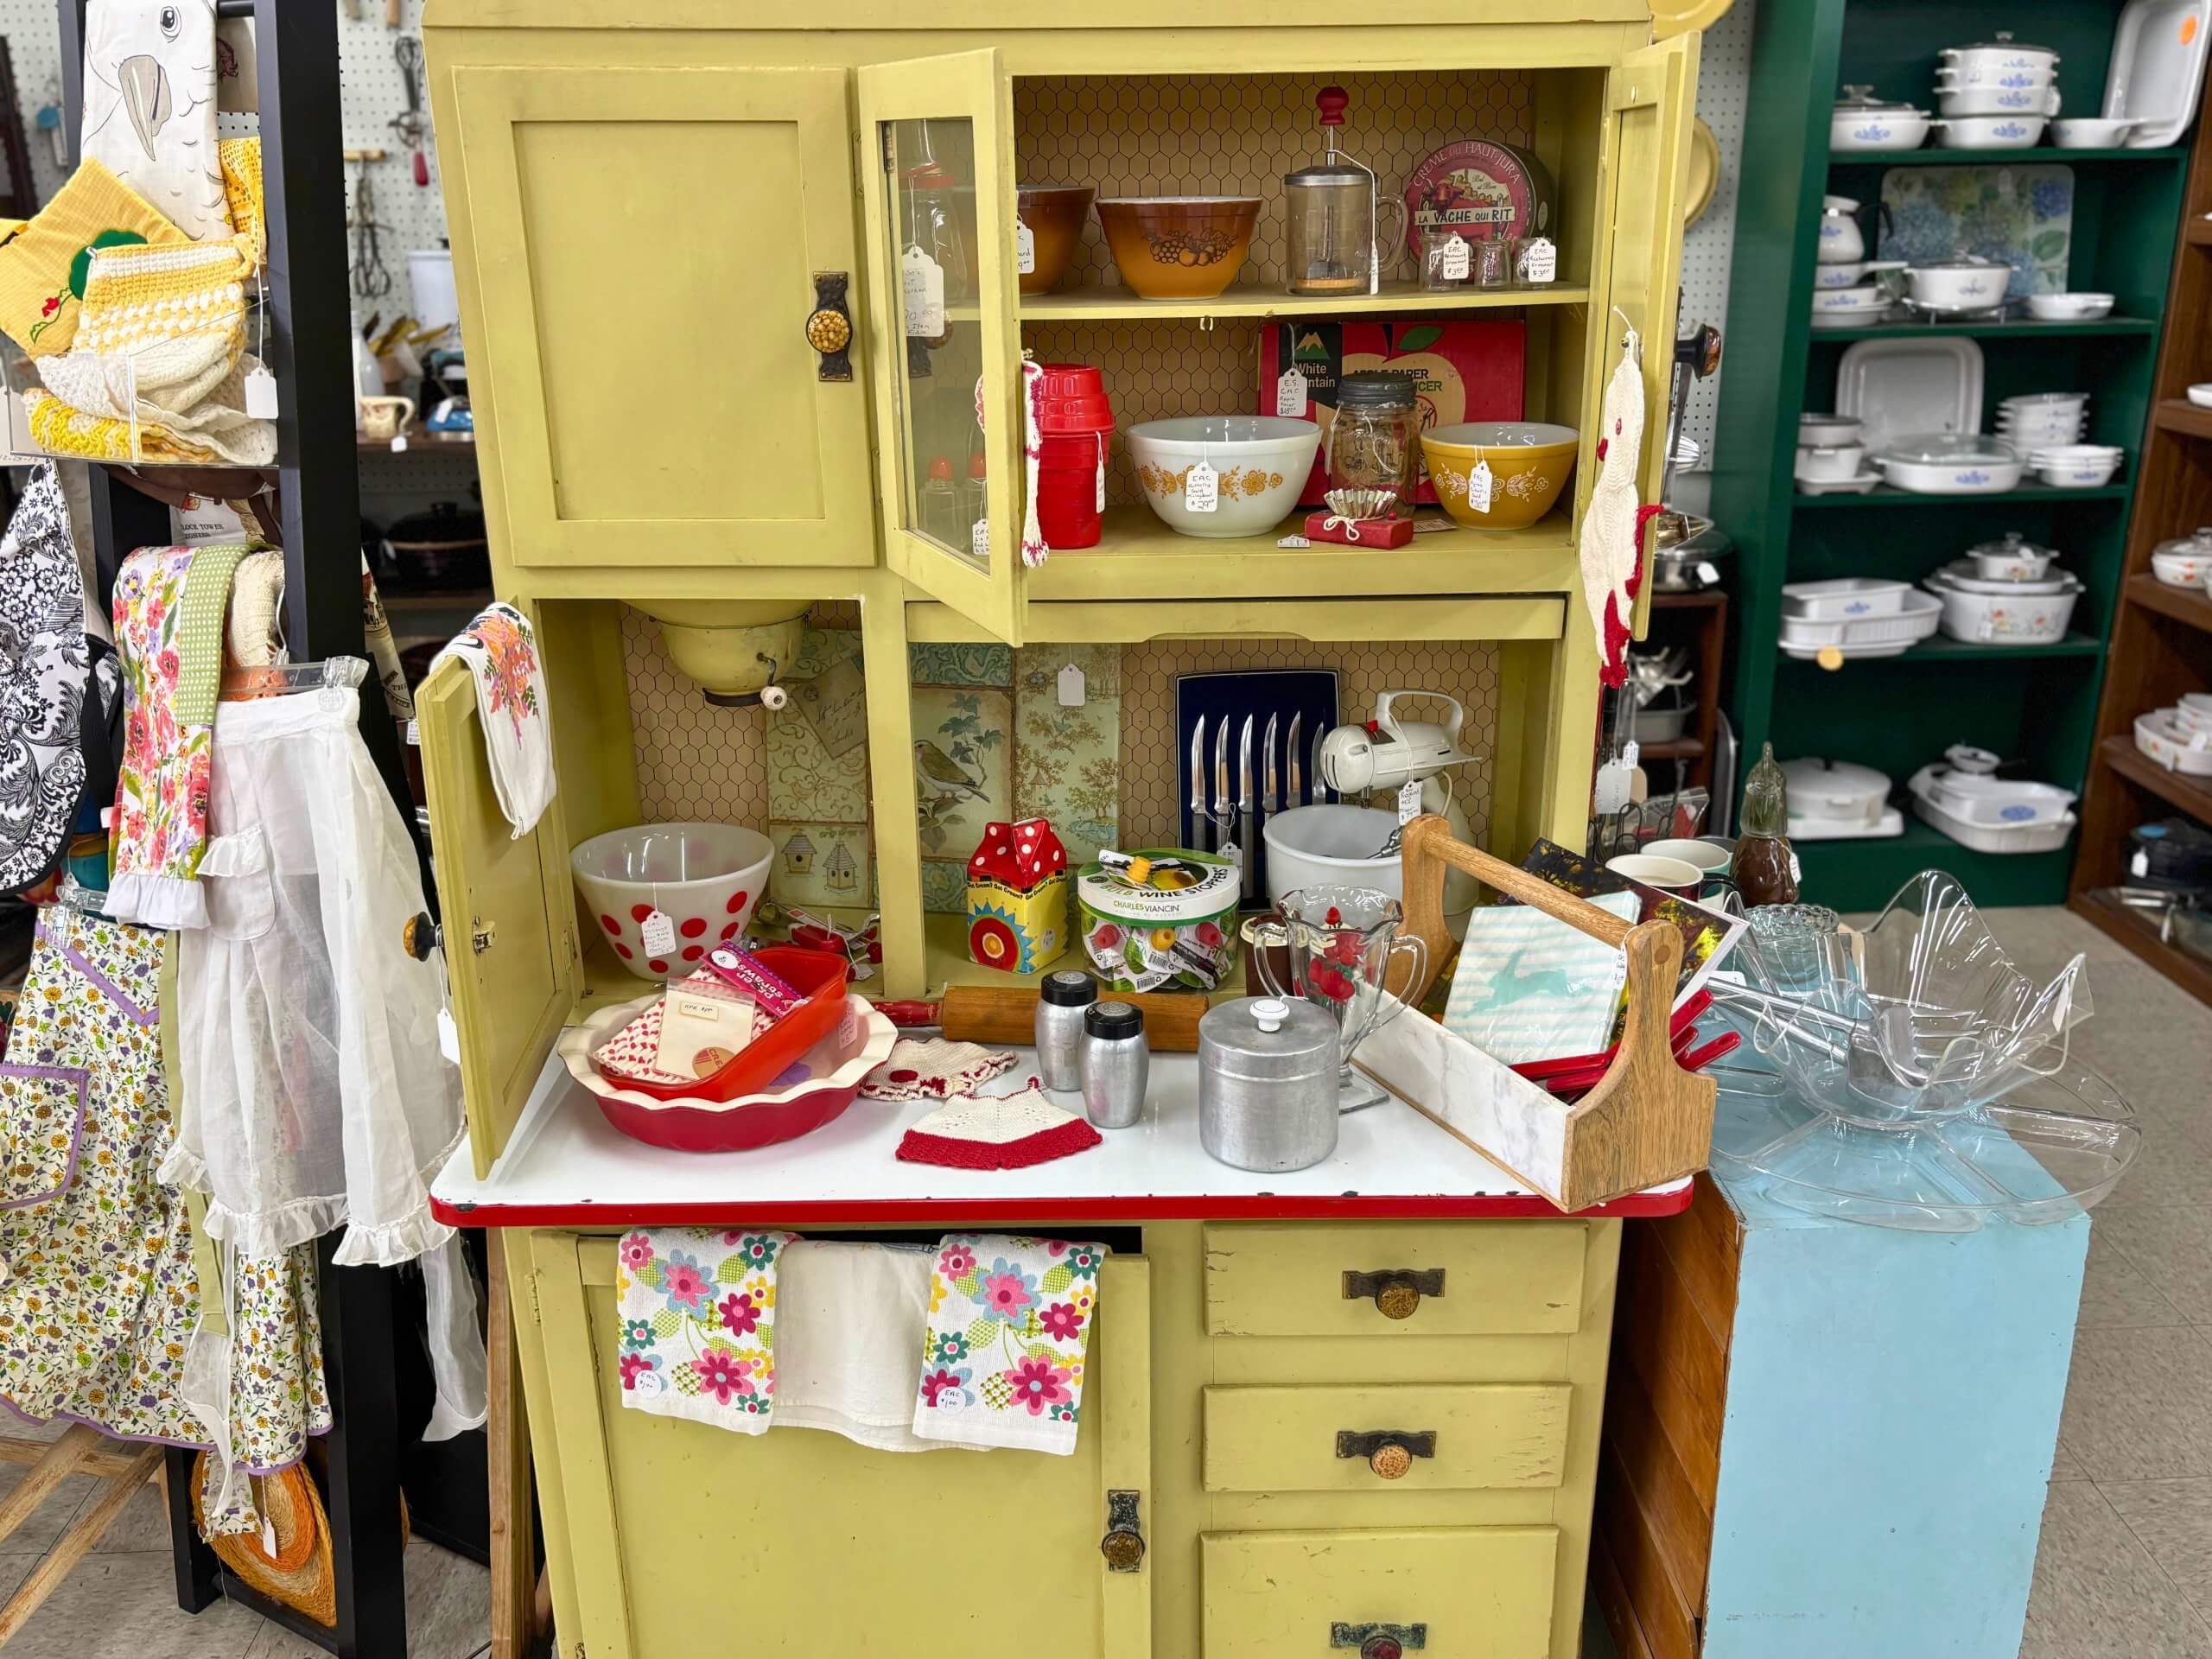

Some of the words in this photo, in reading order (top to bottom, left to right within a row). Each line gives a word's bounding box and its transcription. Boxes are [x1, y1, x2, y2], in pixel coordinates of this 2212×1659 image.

[1419, 214, 1428, 224] LA
[1434, 210, 1471, 223] VACHE
[1475, 212, 1489, 221] QUI
[1492, 208, 1512, 221] RIT
[1298, 362, 1327, 374] White
[1307, 376, 1336, 388] ntain
[1099, 884, 1135, 896] BULB
[1113, 900, 1144, 911] CHARLES
[1144, 904, 1180, 912] VIANCIN
